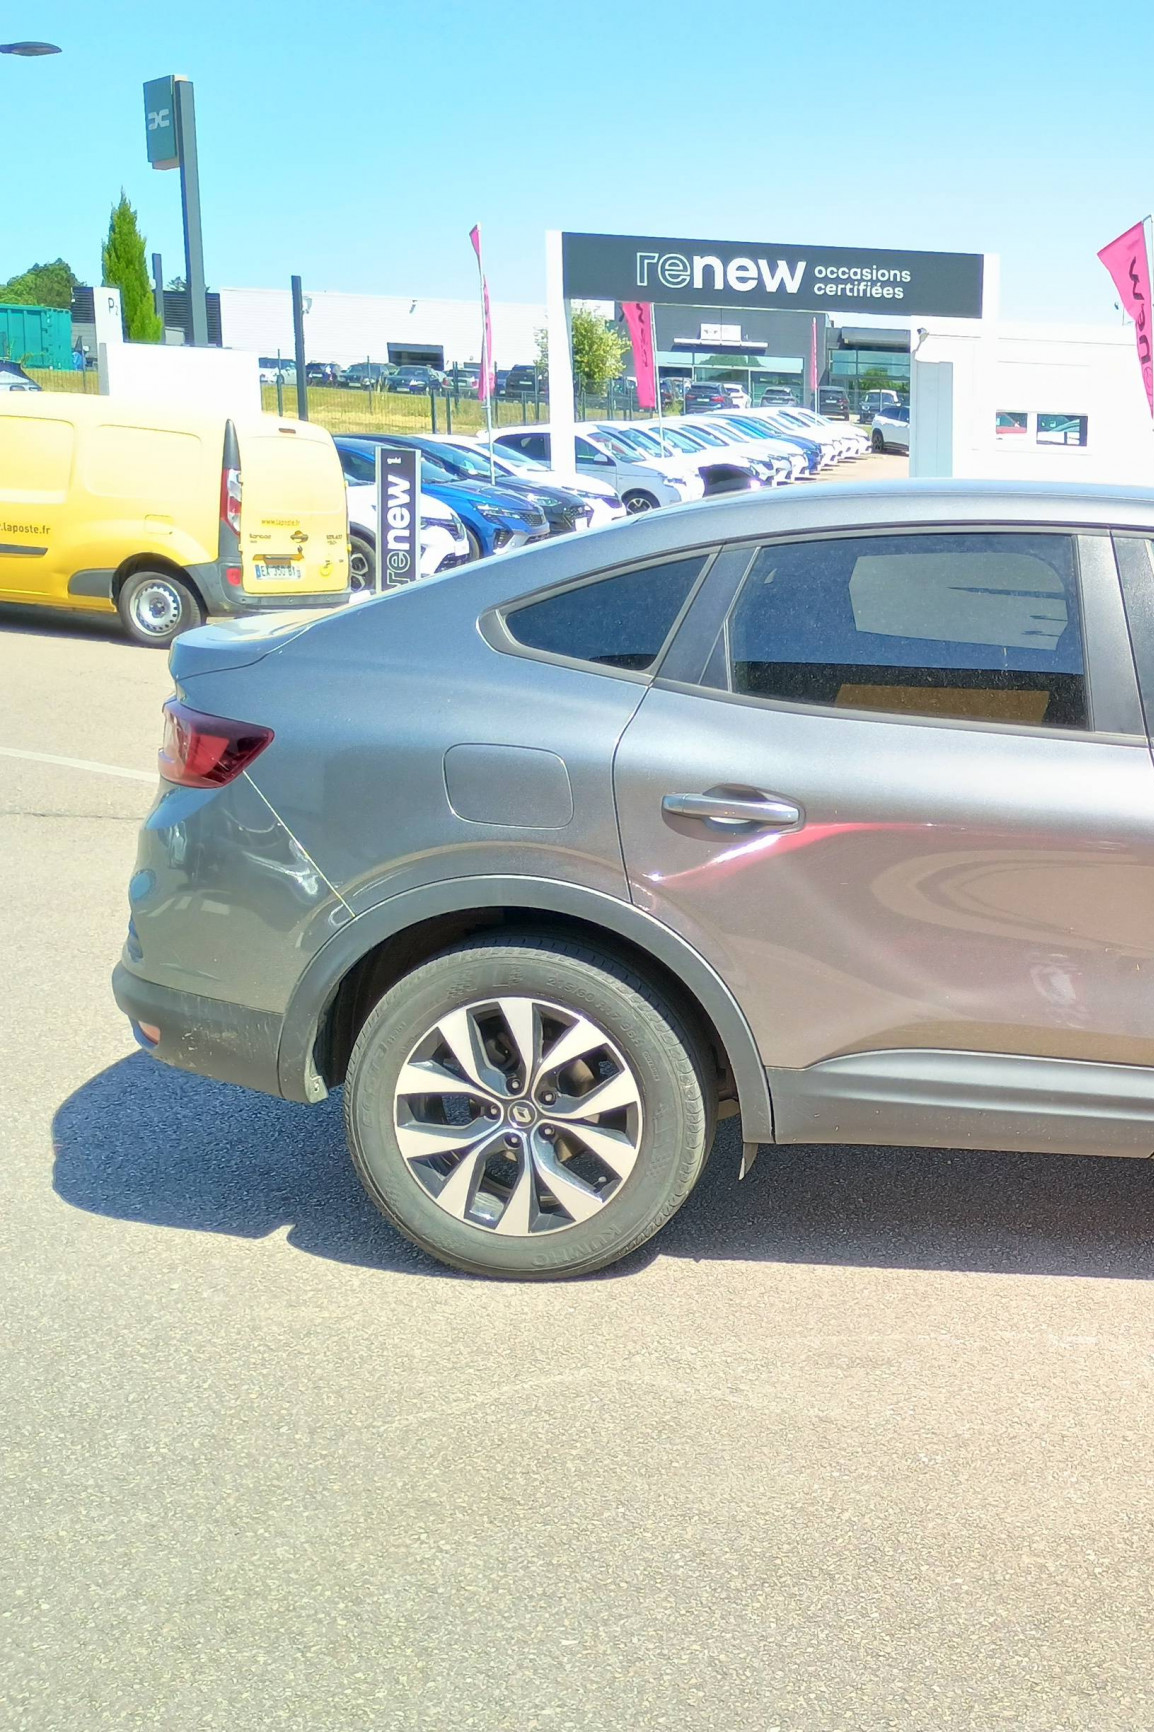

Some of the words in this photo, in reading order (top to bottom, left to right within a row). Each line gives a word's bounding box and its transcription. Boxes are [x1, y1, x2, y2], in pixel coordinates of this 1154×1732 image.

[636, 252, 807, 294] renew
[814, 264, 911, 282] occasions
[813, 280, 904, 299] certifiées
[0, 522, 51, 534] .laposte.fr
[387, 475, 411, 587] renew
